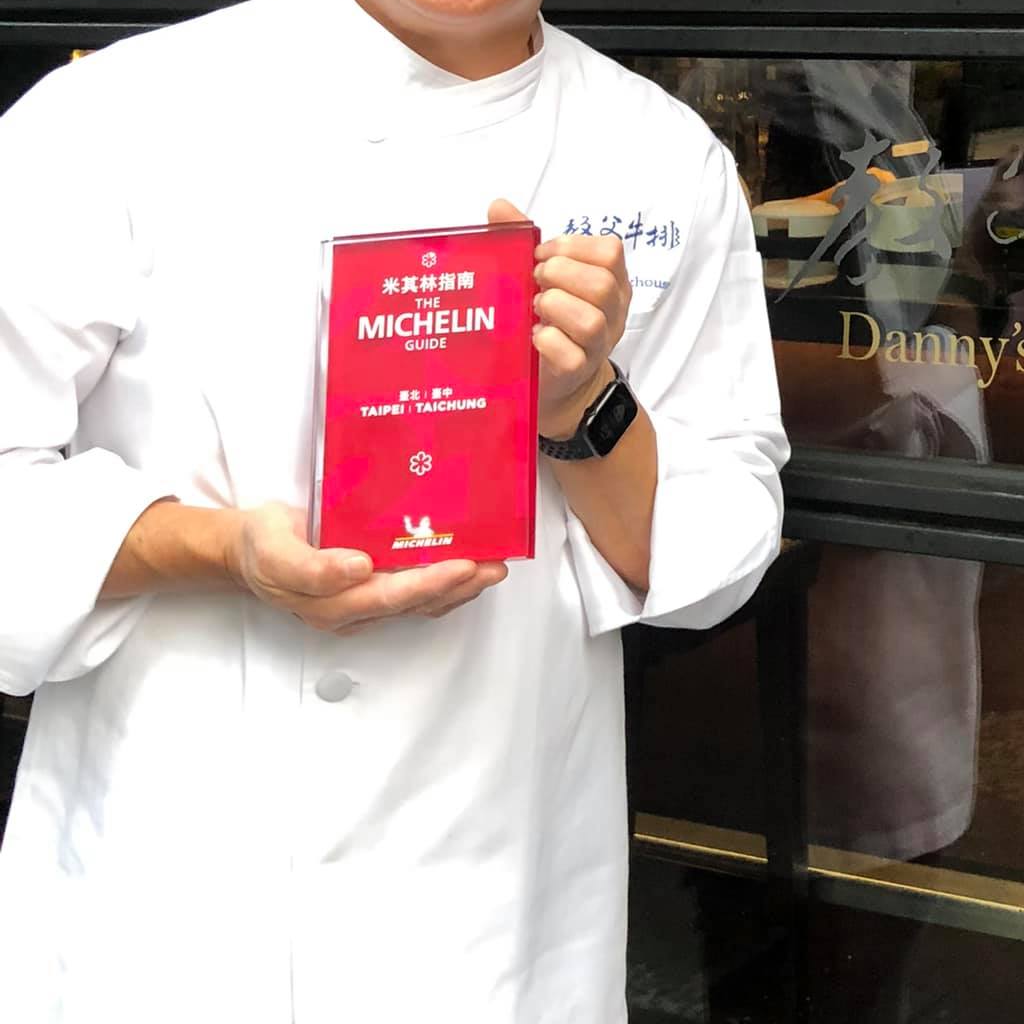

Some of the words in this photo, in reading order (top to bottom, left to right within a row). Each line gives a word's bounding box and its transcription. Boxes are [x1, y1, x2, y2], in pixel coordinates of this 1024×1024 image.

[382, 271, 475, 295] 米其林指南
[415, 296, 441, 309] THE
[357, 306, 496, 340] MICHELIN
[404, 337, 448, 351] GUIDE
[360, 404, 405, 417] TAIPEI
[415, 397, 487, 413] TAICHUNG
[391, 536, 454, 549] MICHELIN
